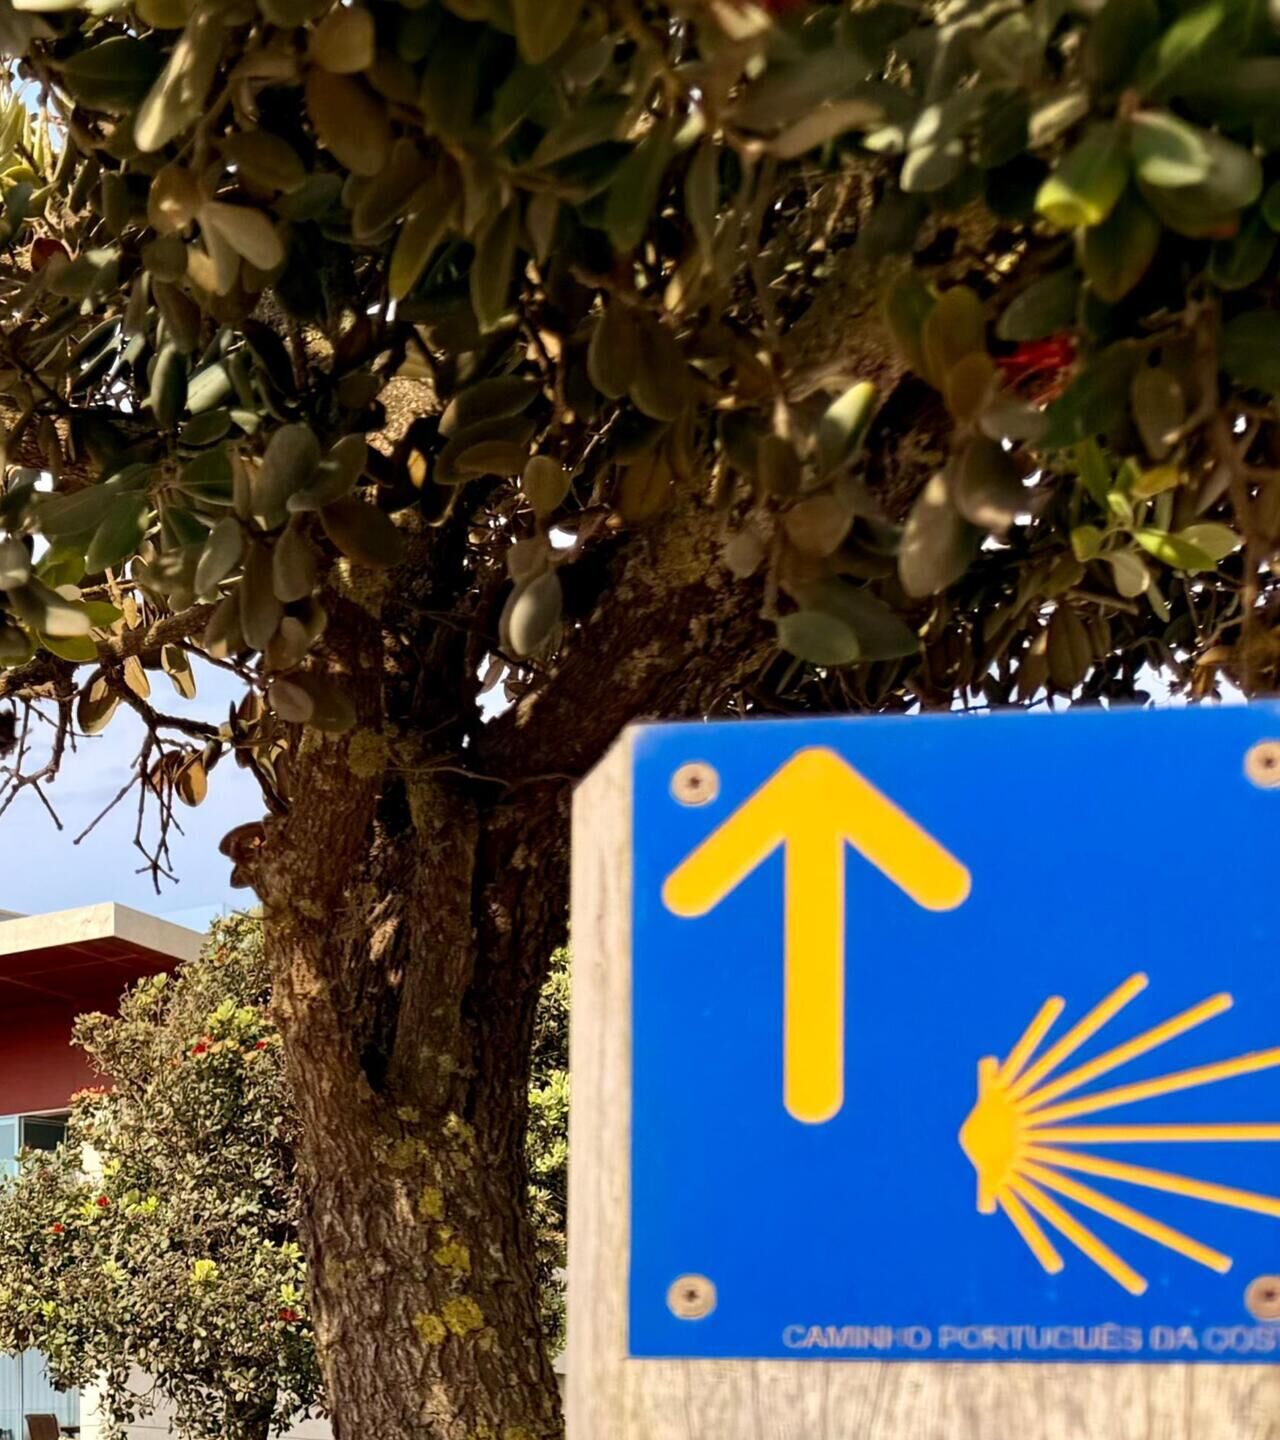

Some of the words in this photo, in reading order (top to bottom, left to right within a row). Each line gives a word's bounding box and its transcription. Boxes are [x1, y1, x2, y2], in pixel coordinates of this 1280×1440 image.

[782, 1324, 932, 1350] CAMINHO
[938, 1323, 1143, 1351] PORTUGUÊS
[1149, 1325, 1198, 1350] DA
[1202, 1325, 1280, 1352] COS
